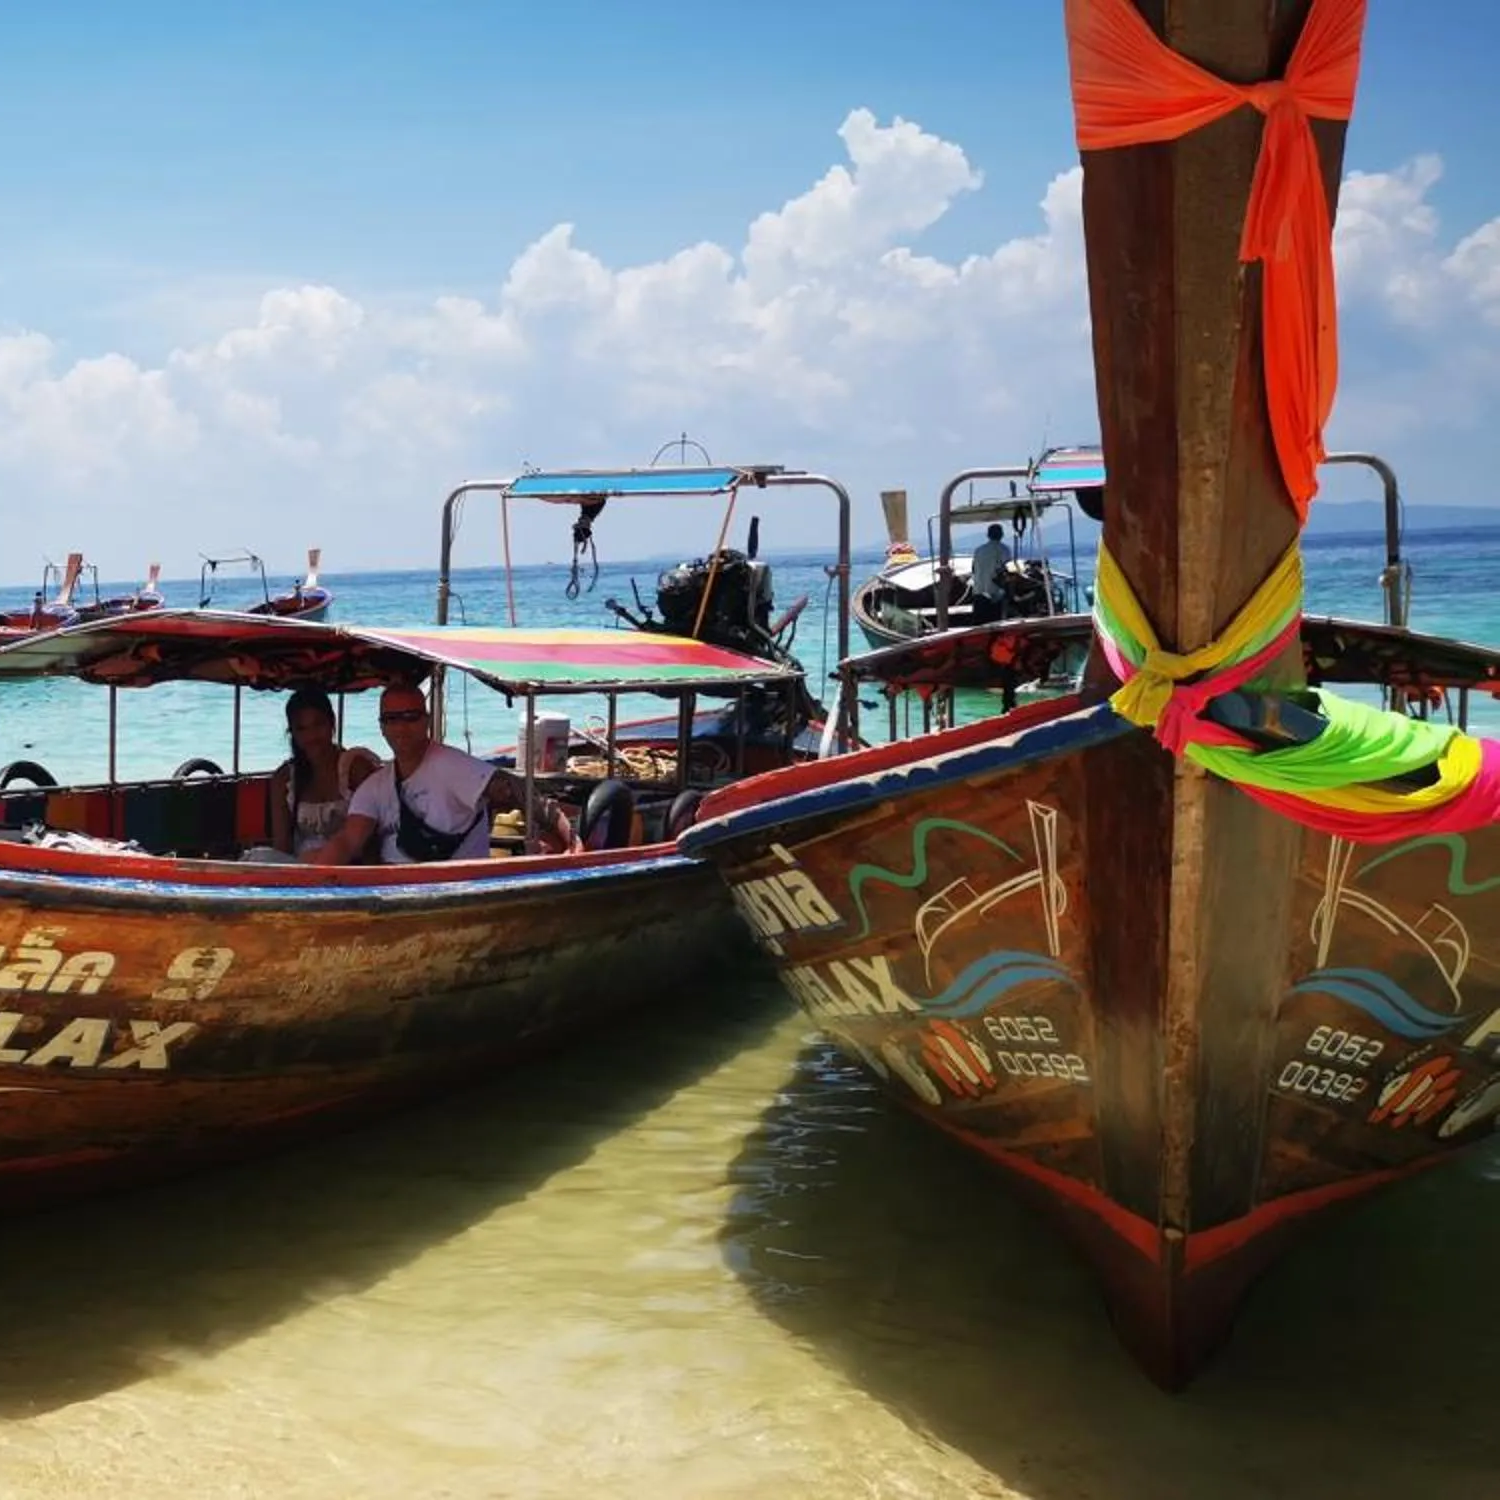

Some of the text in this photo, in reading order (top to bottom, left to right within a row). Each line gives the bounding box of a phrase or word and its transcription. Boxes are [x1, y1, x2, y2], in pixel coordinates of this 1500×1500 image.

[983, 1016, 1060, 1042] 6052
[1305, 1025, 1385, 1068] 6052
[997, 1051, 1090, 1082] 00392
[1278, 1061, 1369, 1101] 00392
